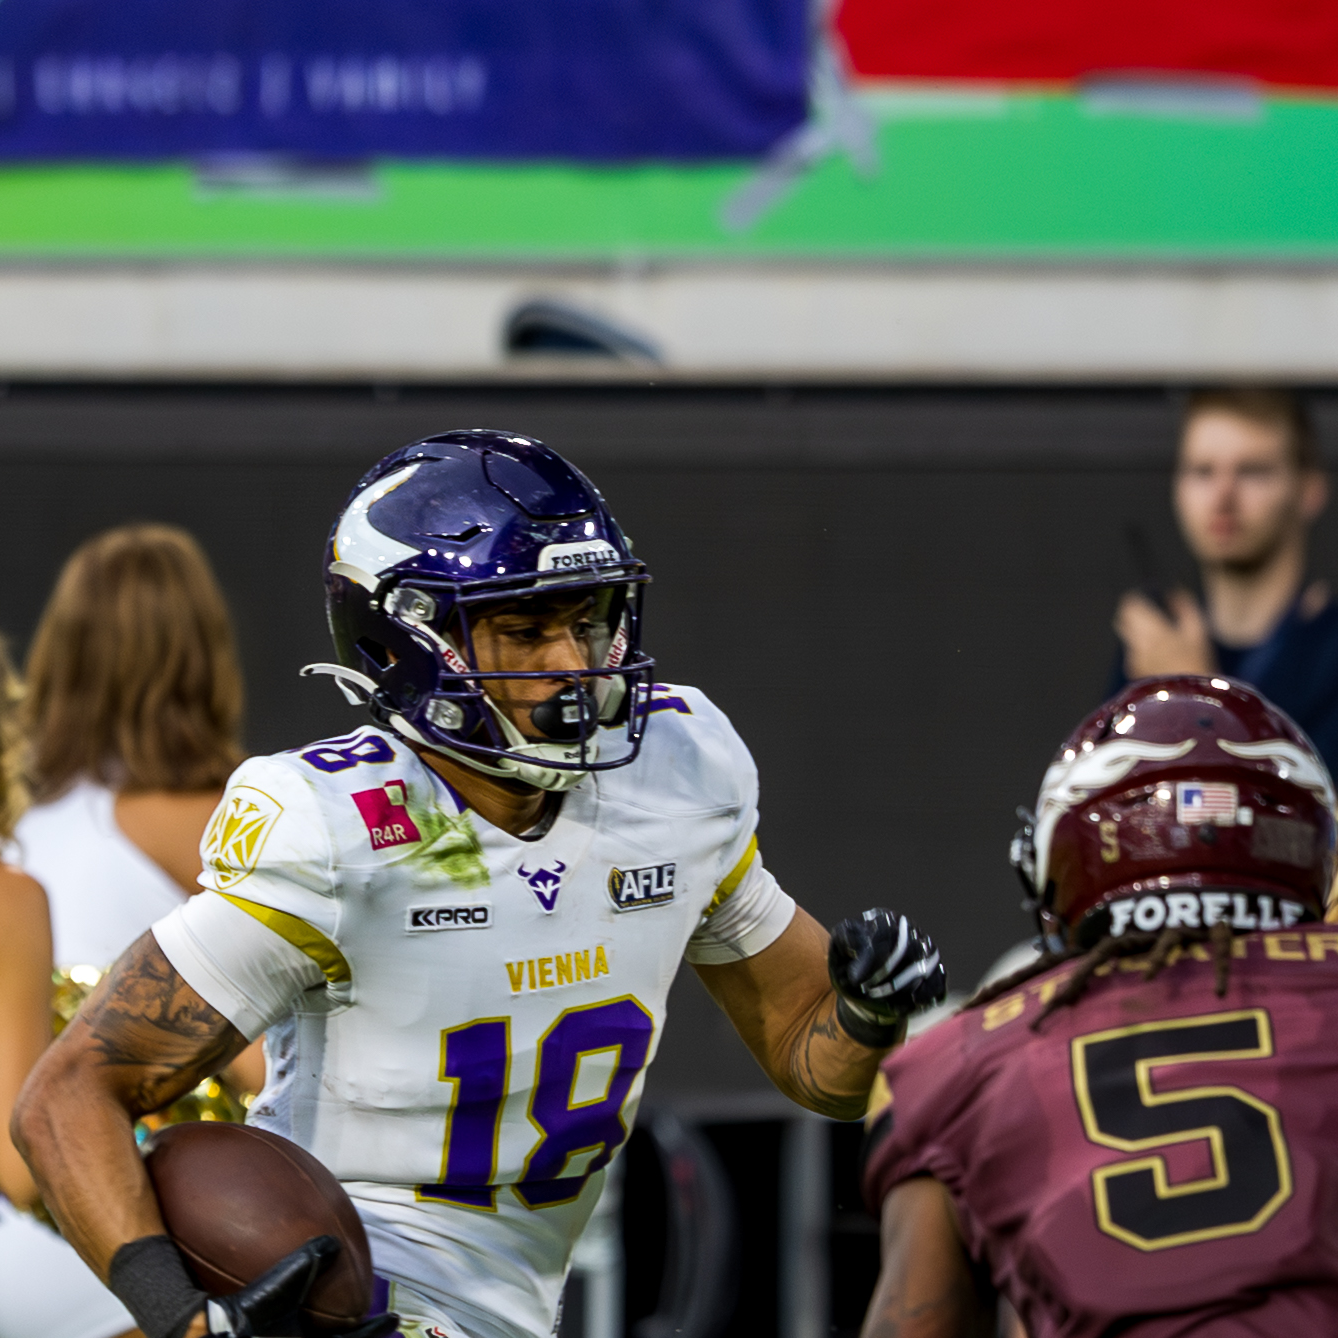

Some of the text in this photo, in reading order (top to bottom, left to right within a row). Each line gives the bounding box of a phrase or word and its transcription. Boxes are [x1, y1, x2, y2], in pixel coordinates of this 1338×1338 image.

[551, 549, 616, 570] FORELLE
[371, 823, 408, 846] R4R
[619, 864, 675, 902] AFLE
[505, 945, 610, 993] VIENNA
[415, 993, 655, 1213] 18
[1072, 1008, 1293, 1251] 5
